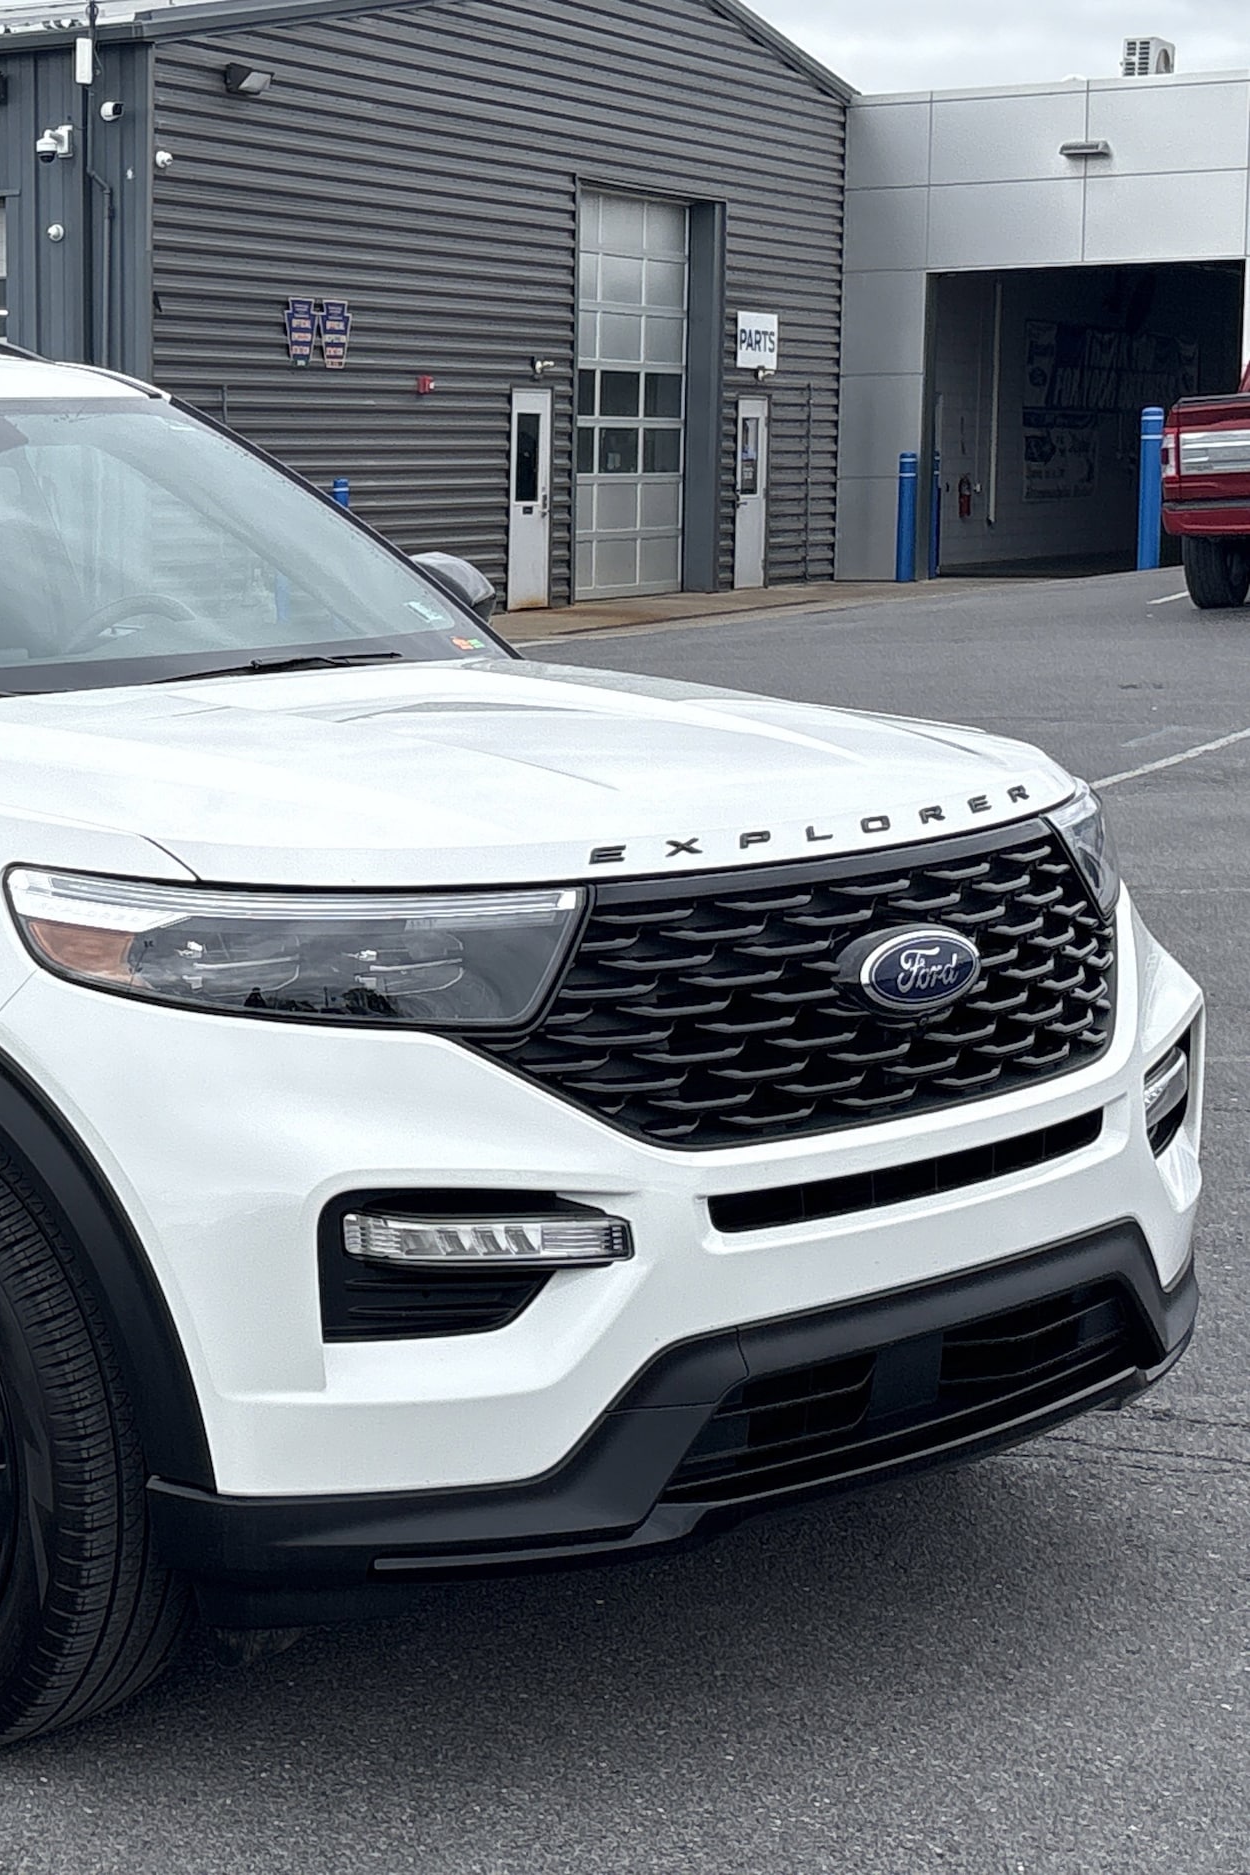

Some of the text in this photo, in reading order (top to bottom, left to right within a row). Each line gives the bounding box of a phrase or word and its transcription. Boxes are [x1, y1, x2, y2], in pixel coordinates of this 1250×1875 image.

[739, 328, 775, 353] PARTS
[588, 784, 1030, 865] EXPLORER
[897, 946, 958, 993] Ford
